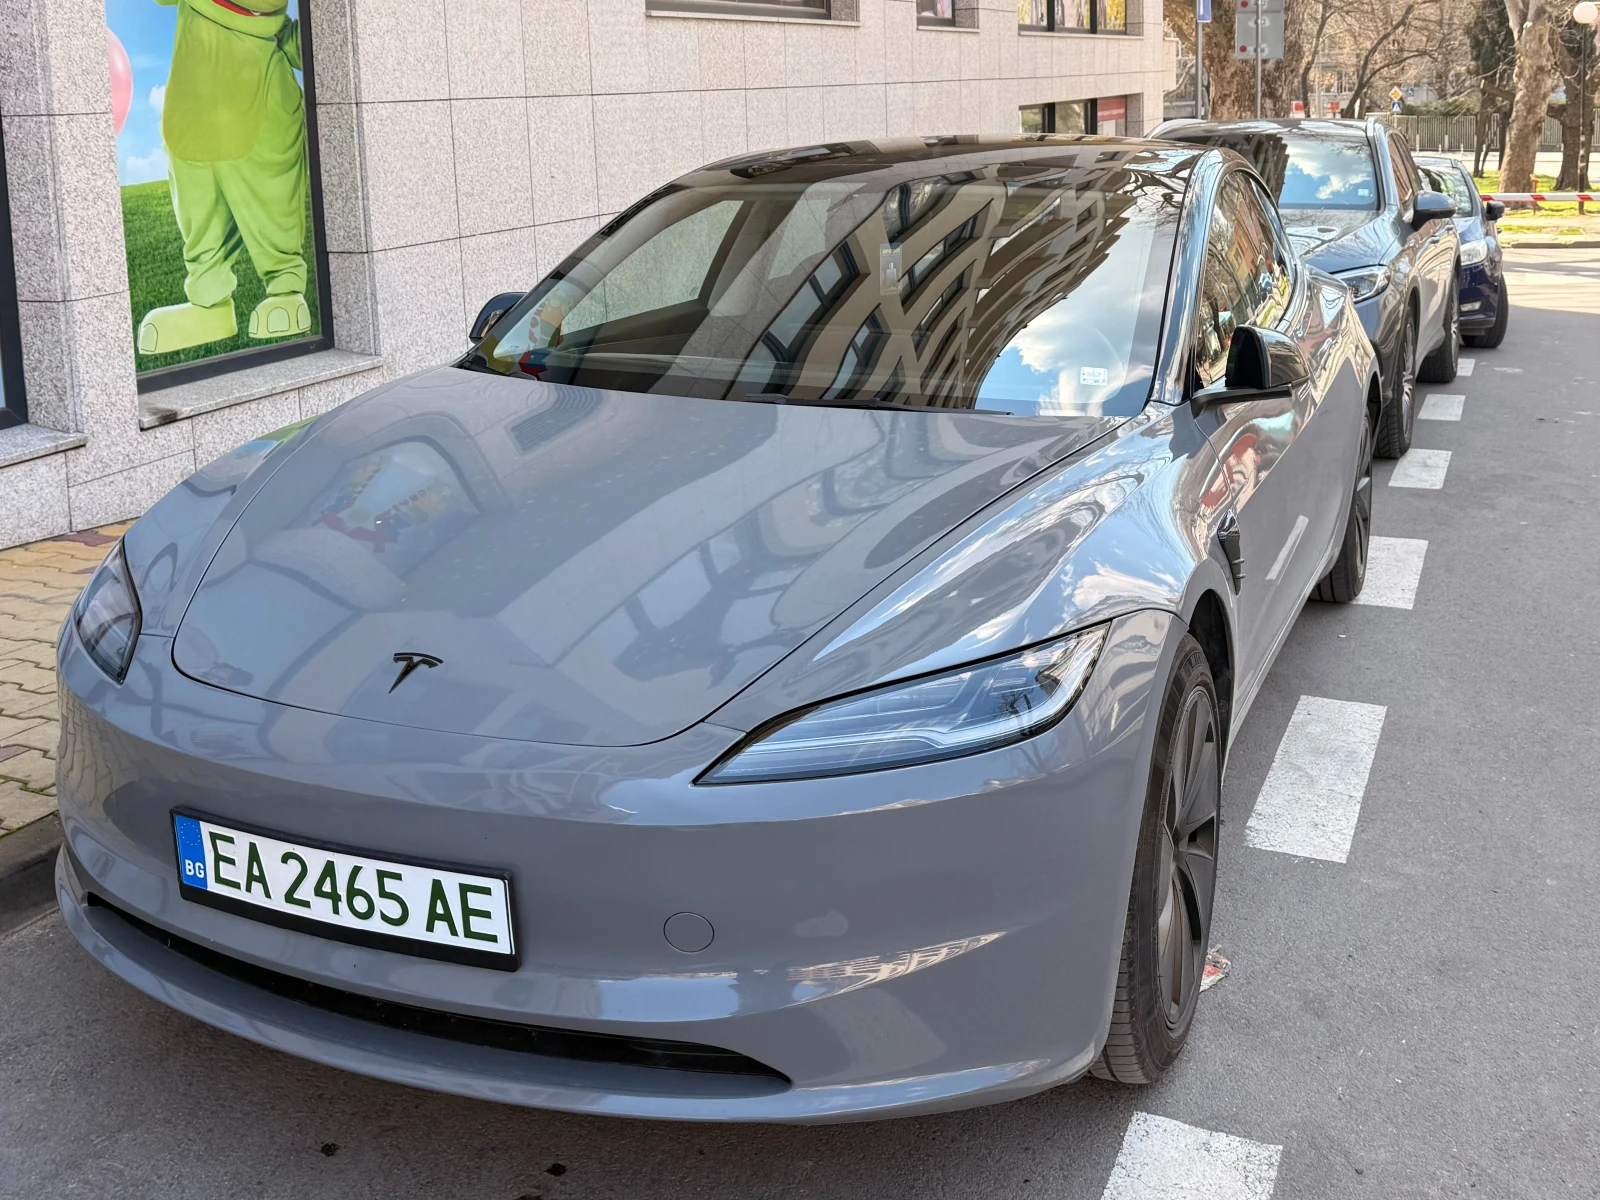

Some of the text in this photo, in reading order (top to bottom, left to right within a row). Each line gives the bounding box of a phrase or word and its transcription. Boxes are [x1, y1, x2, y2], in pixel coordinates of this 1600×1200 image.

[184, 858, 205, 879] BG
[208, 830, 499, 944] EA 2465 AE
